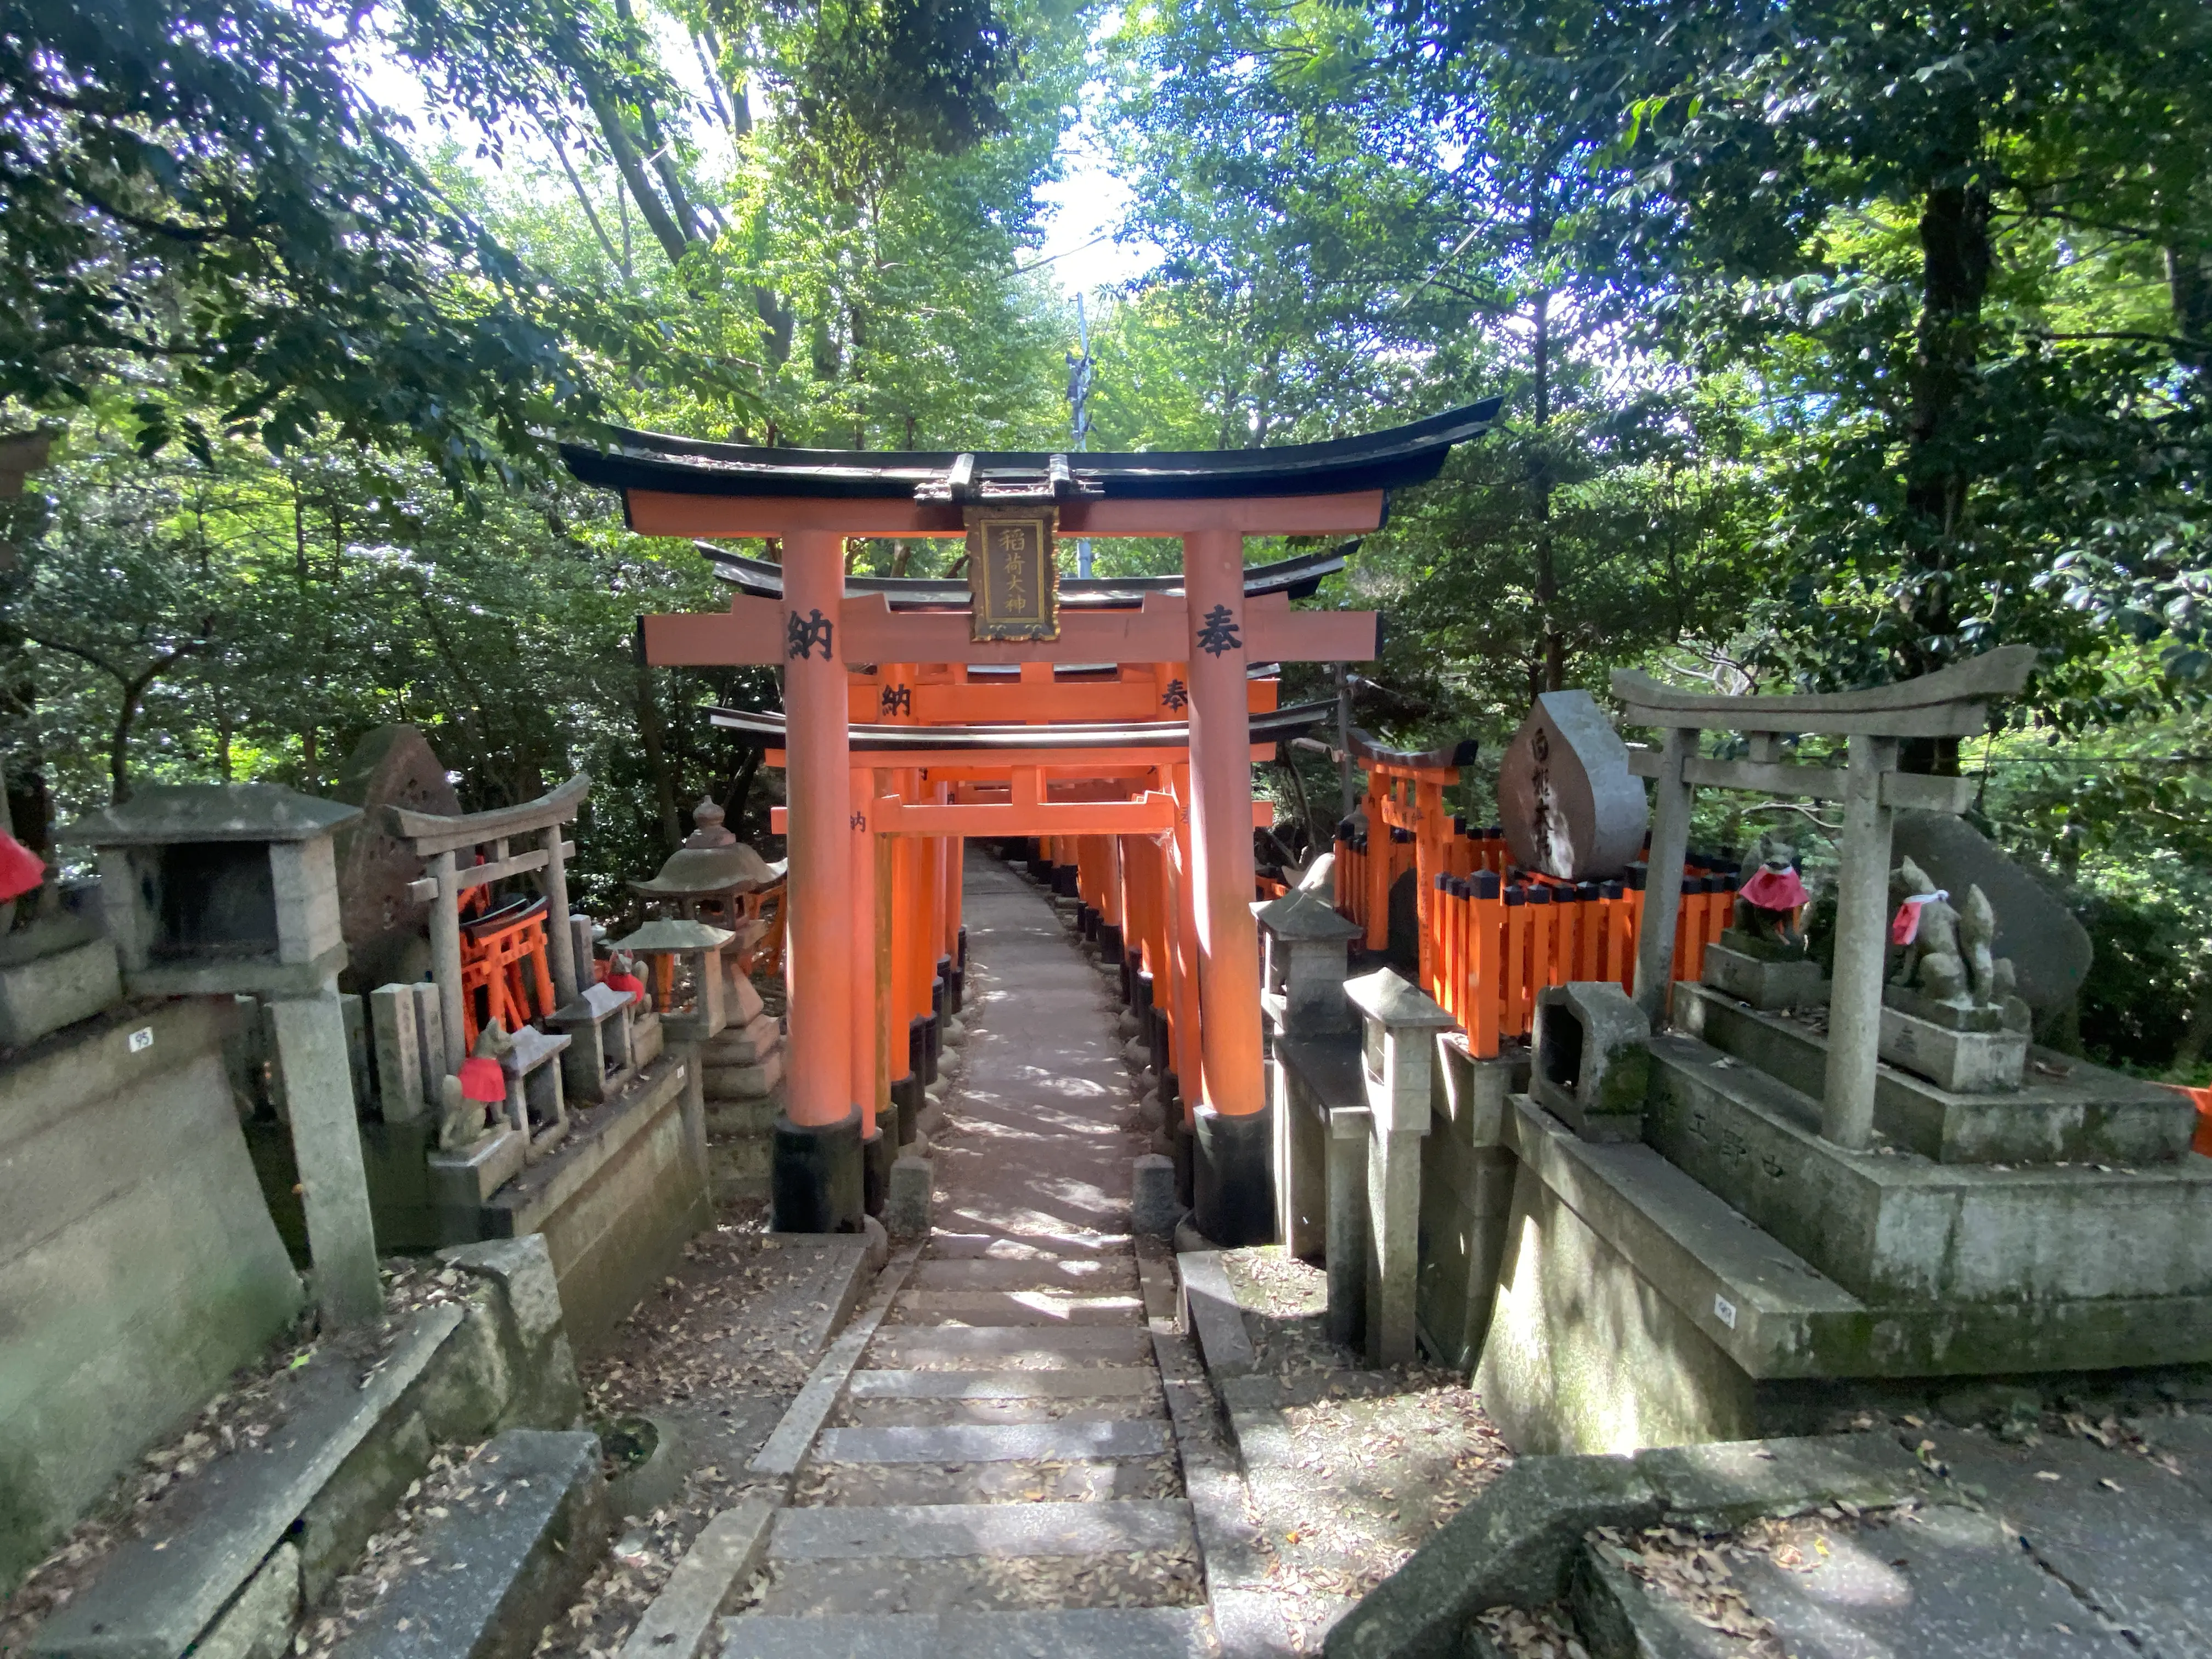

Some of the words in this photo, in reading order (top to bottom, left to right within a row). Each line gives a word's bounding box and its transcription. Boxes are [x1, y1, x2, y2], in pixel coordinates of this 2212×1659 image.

[788, 608, 834, 662] 納
[1196, 604, 1243, 659] 奉
[882, 684, 911, 717] 納
[1161, 678, 1188, 714] 奉
